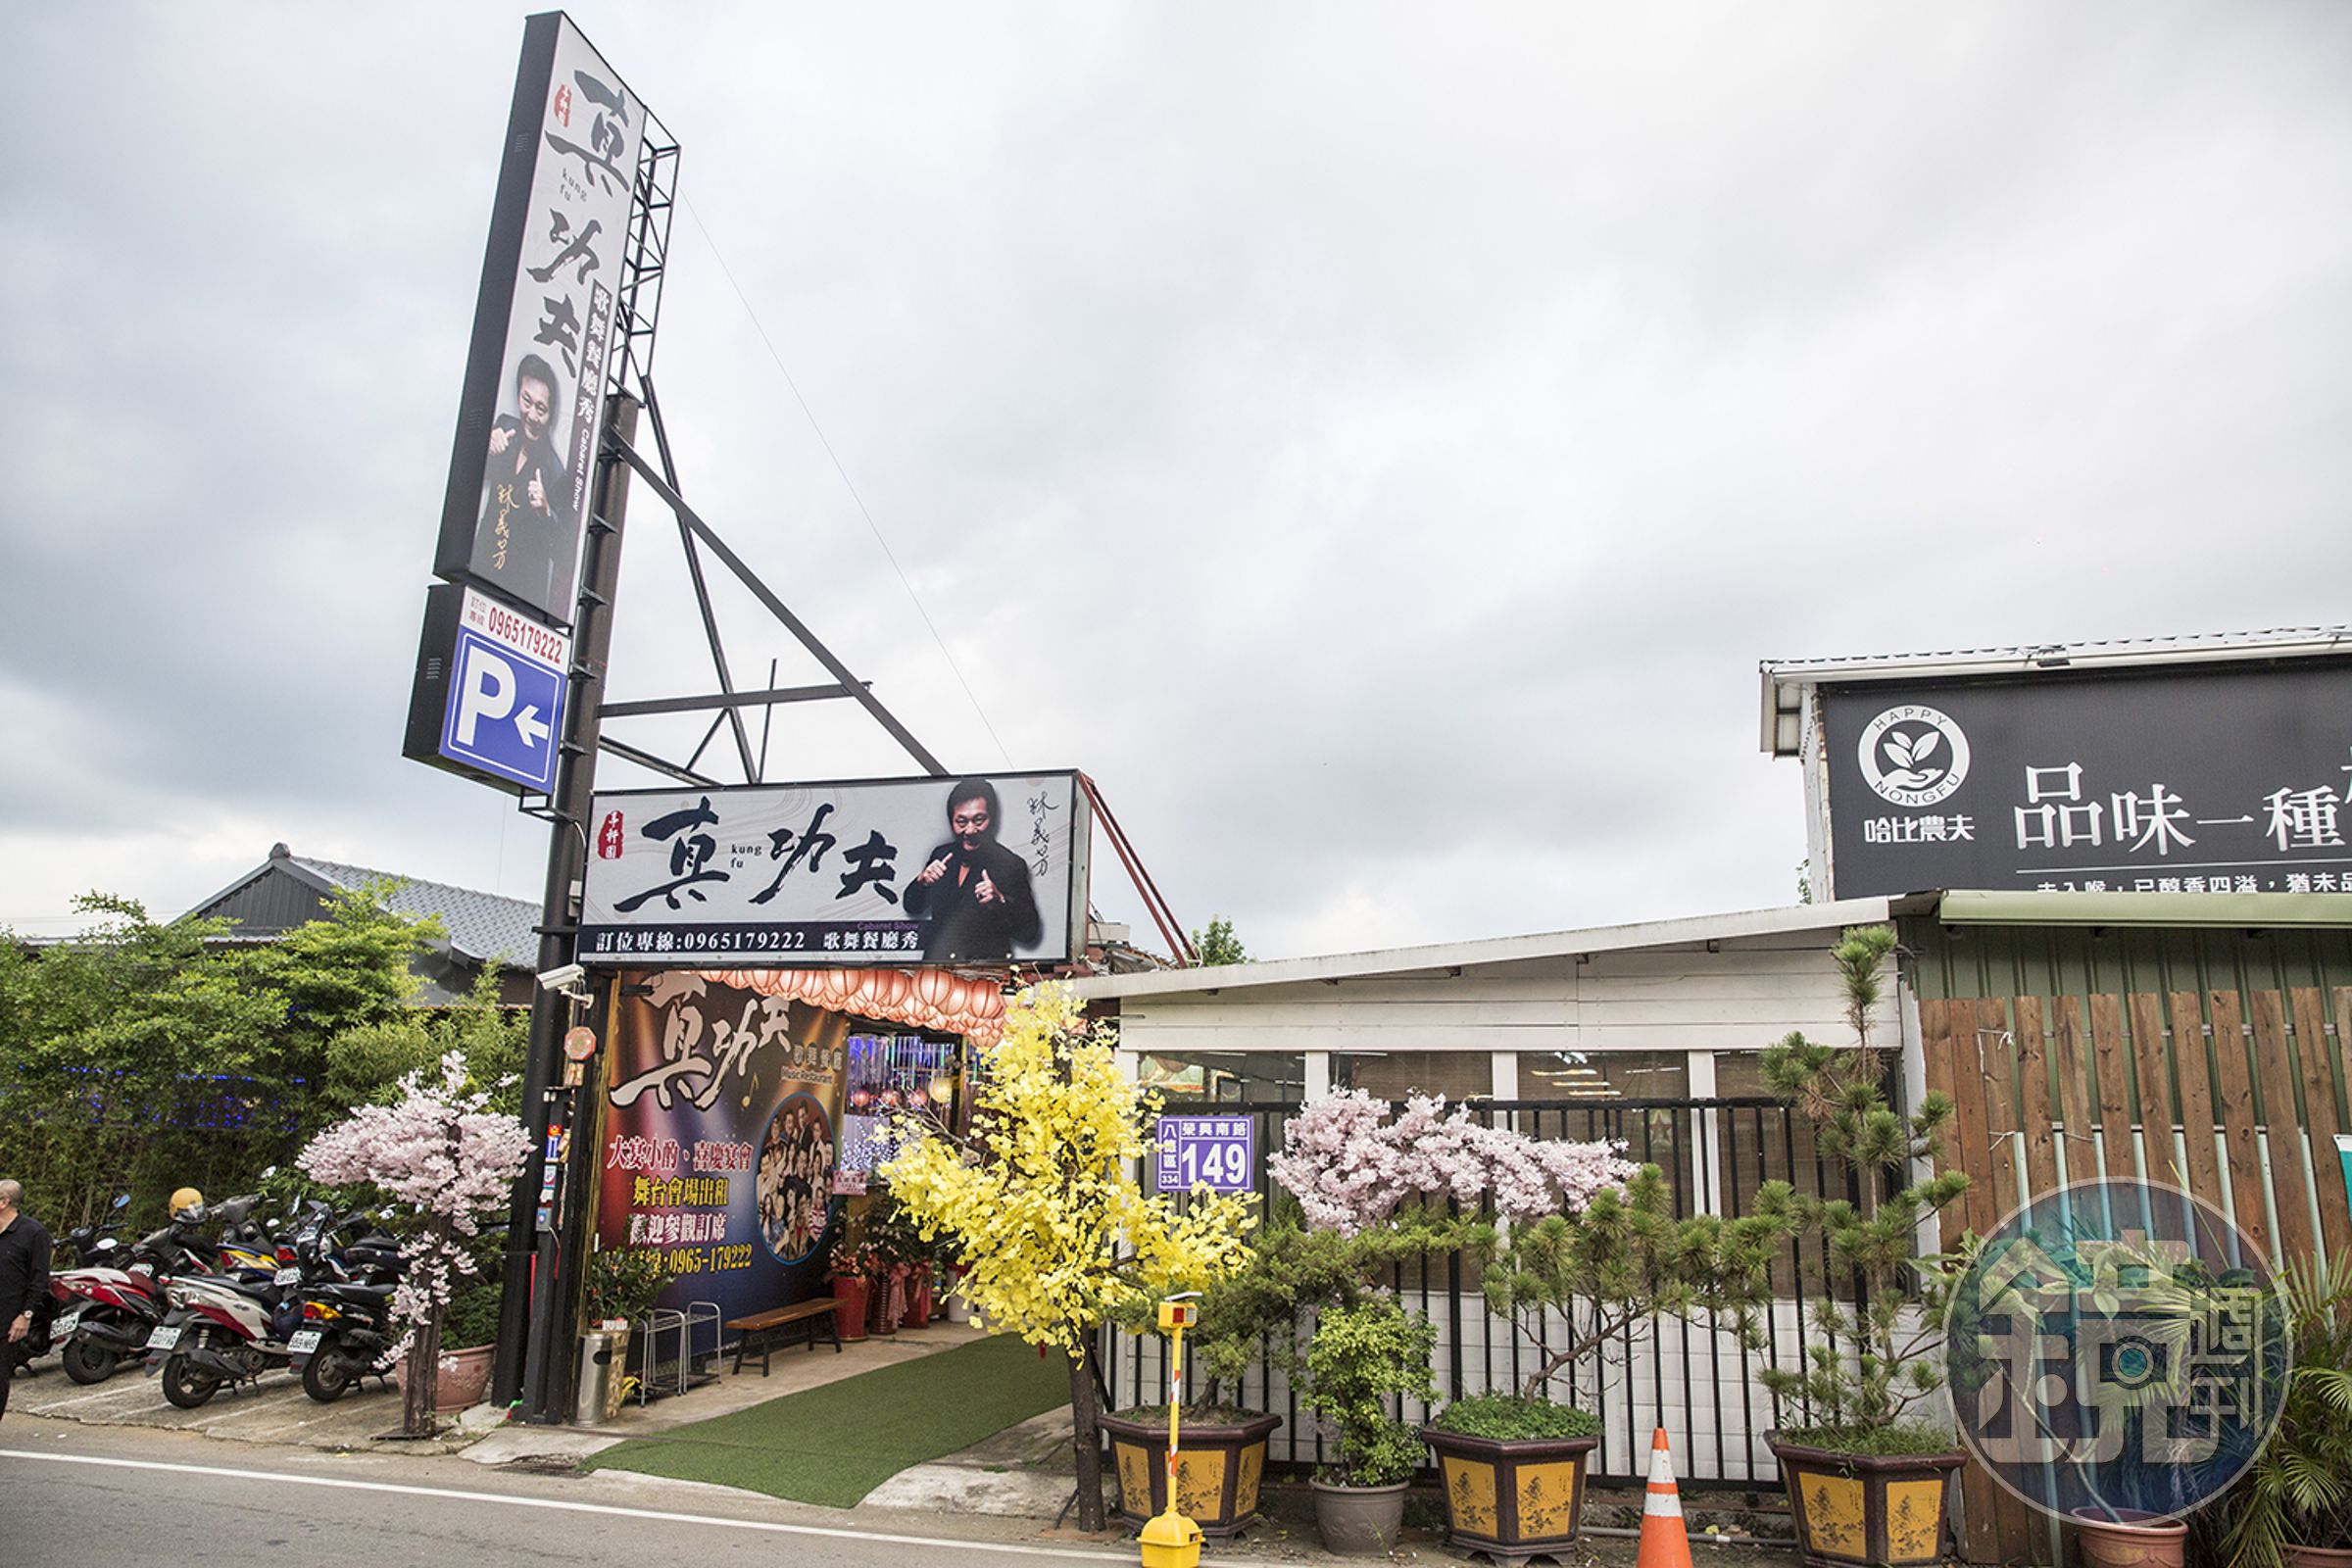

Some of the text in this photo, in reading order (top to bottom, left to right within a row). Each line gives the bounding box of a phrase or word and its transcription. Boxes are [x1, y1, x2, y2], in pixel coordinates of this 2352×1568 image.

[560, 187, 571, 202] fu
[562, 169, 587, 202] kung
[572, 428, 590, 512] Cabaret Show
[488, 607, 563, 664] 0965179222
[456, 644, 516, 747] P
[1874, 707, 1948, 731] HAPPY
[1875, 773, 1961, 805] NONGFU
[2014, 746, 2352, 856] 品味一種
[1864, 814, 1976, 844] 哈比農夫
[731, 844, 761, 857] kung
[731, 857, 744, 869] fu
[822, 932, 918, 951] 歌舞餐廳秀
[1182, 1122, 1246, 1136] 榮興南路
[1182, 1143, 1246, 1184] 149
[632, 1175, 729, 1207] 舞台會場出租
[1161, 1175, 1178, 1184] 334
